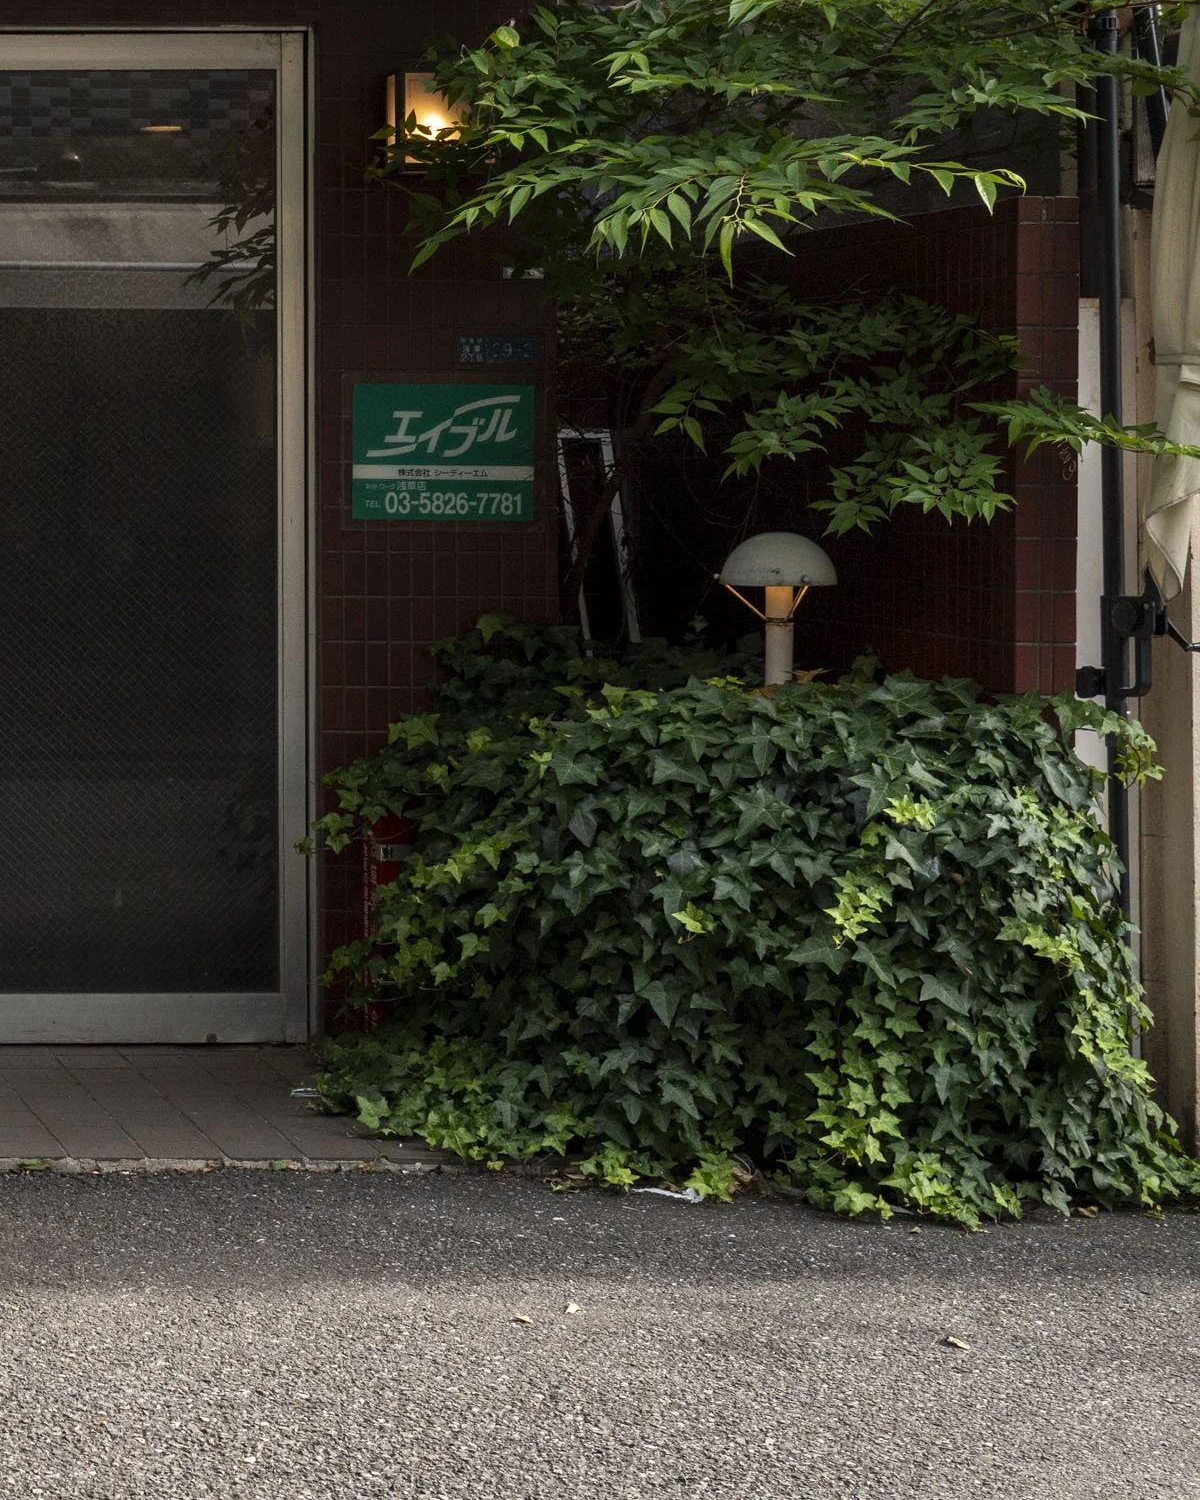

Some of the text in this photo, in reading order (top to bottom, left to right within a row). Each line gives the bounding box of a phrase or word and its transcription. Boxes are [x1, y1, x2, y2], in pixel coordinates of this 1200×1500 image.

[366, 395, 521, 458] エイブル
[397, 468, 489, 478] 株式会社 シーディーエム
[365, 491, 522, 515] TEL 03-5826-7781
